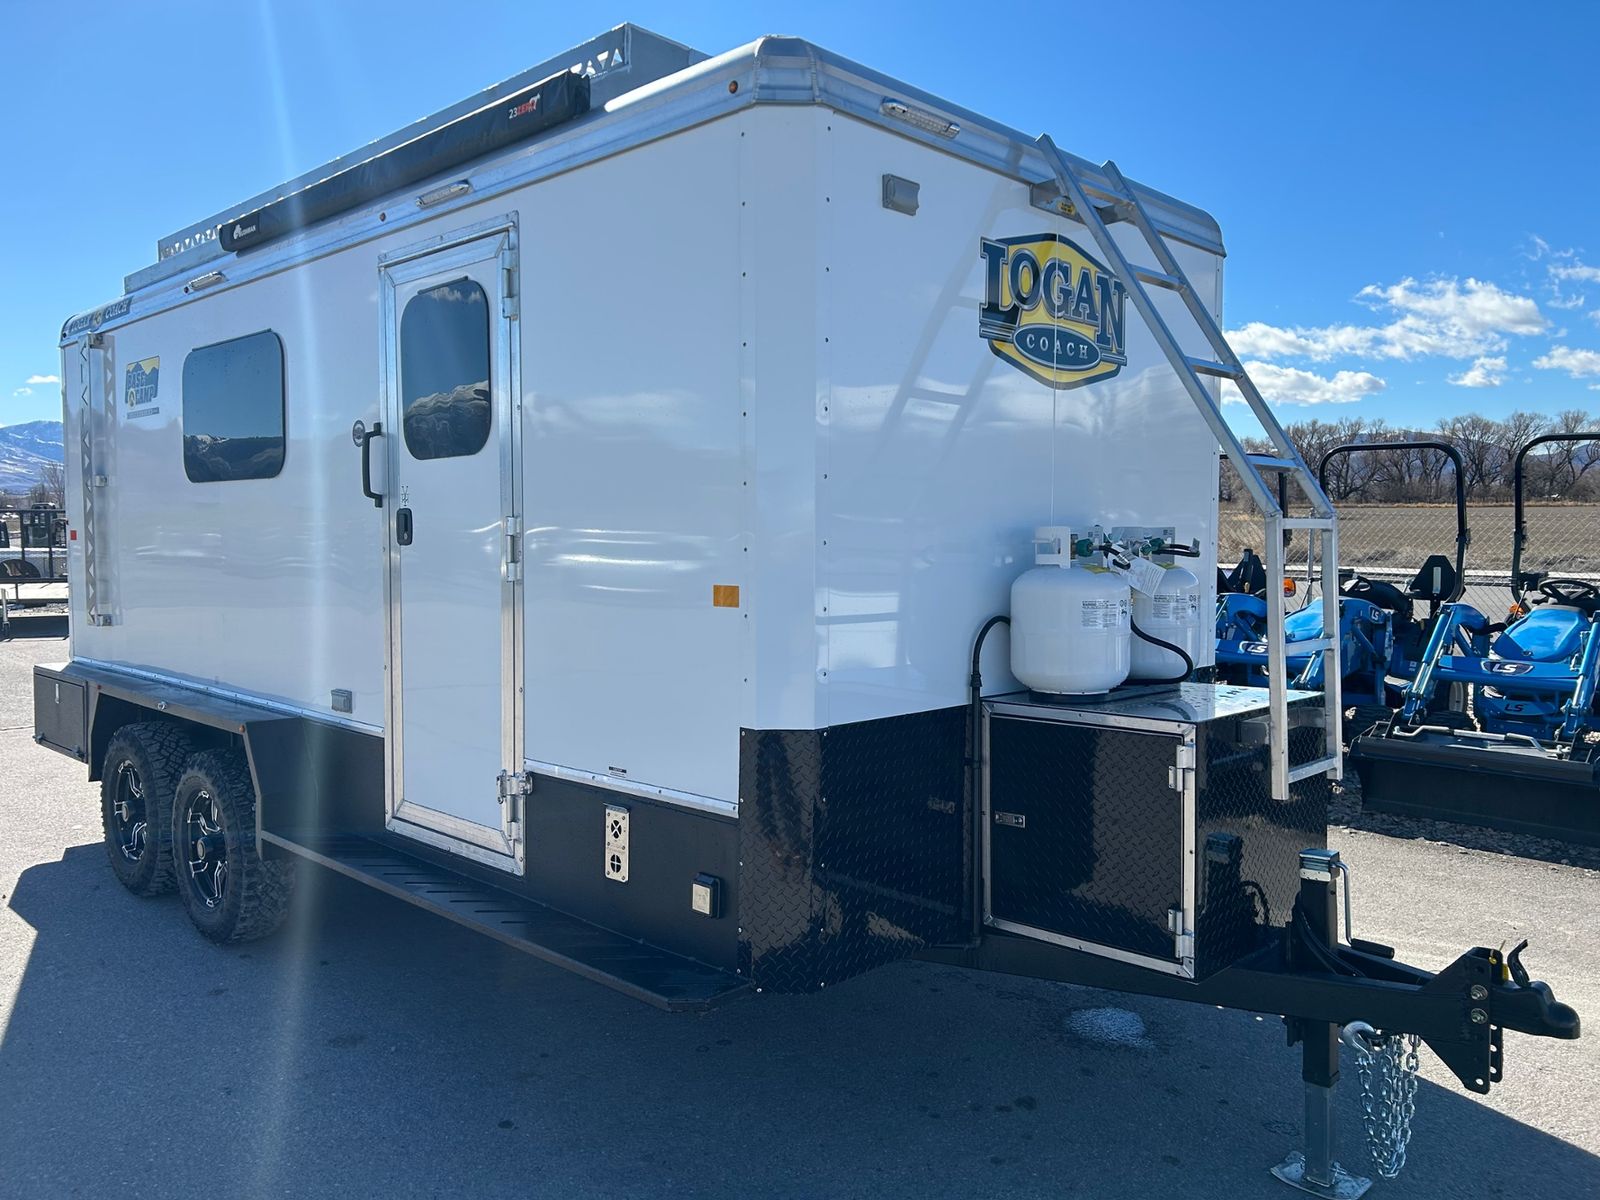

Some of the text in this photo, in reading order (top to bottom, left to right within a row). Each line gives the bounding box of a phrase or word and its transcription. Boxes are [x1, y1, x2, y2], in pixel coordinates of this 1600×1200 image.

[979, 235, 1129, 355] LOGAN
[1025, 333, 1089, 360] COACH
[127, 370, 146, 390] BASE
[136, 383, 156, 405] CAMP
[1369, 608, 1381, 621] LS
[1247, 644, 1268, 653] LS
[1492, 663, 1518, 673] LS
